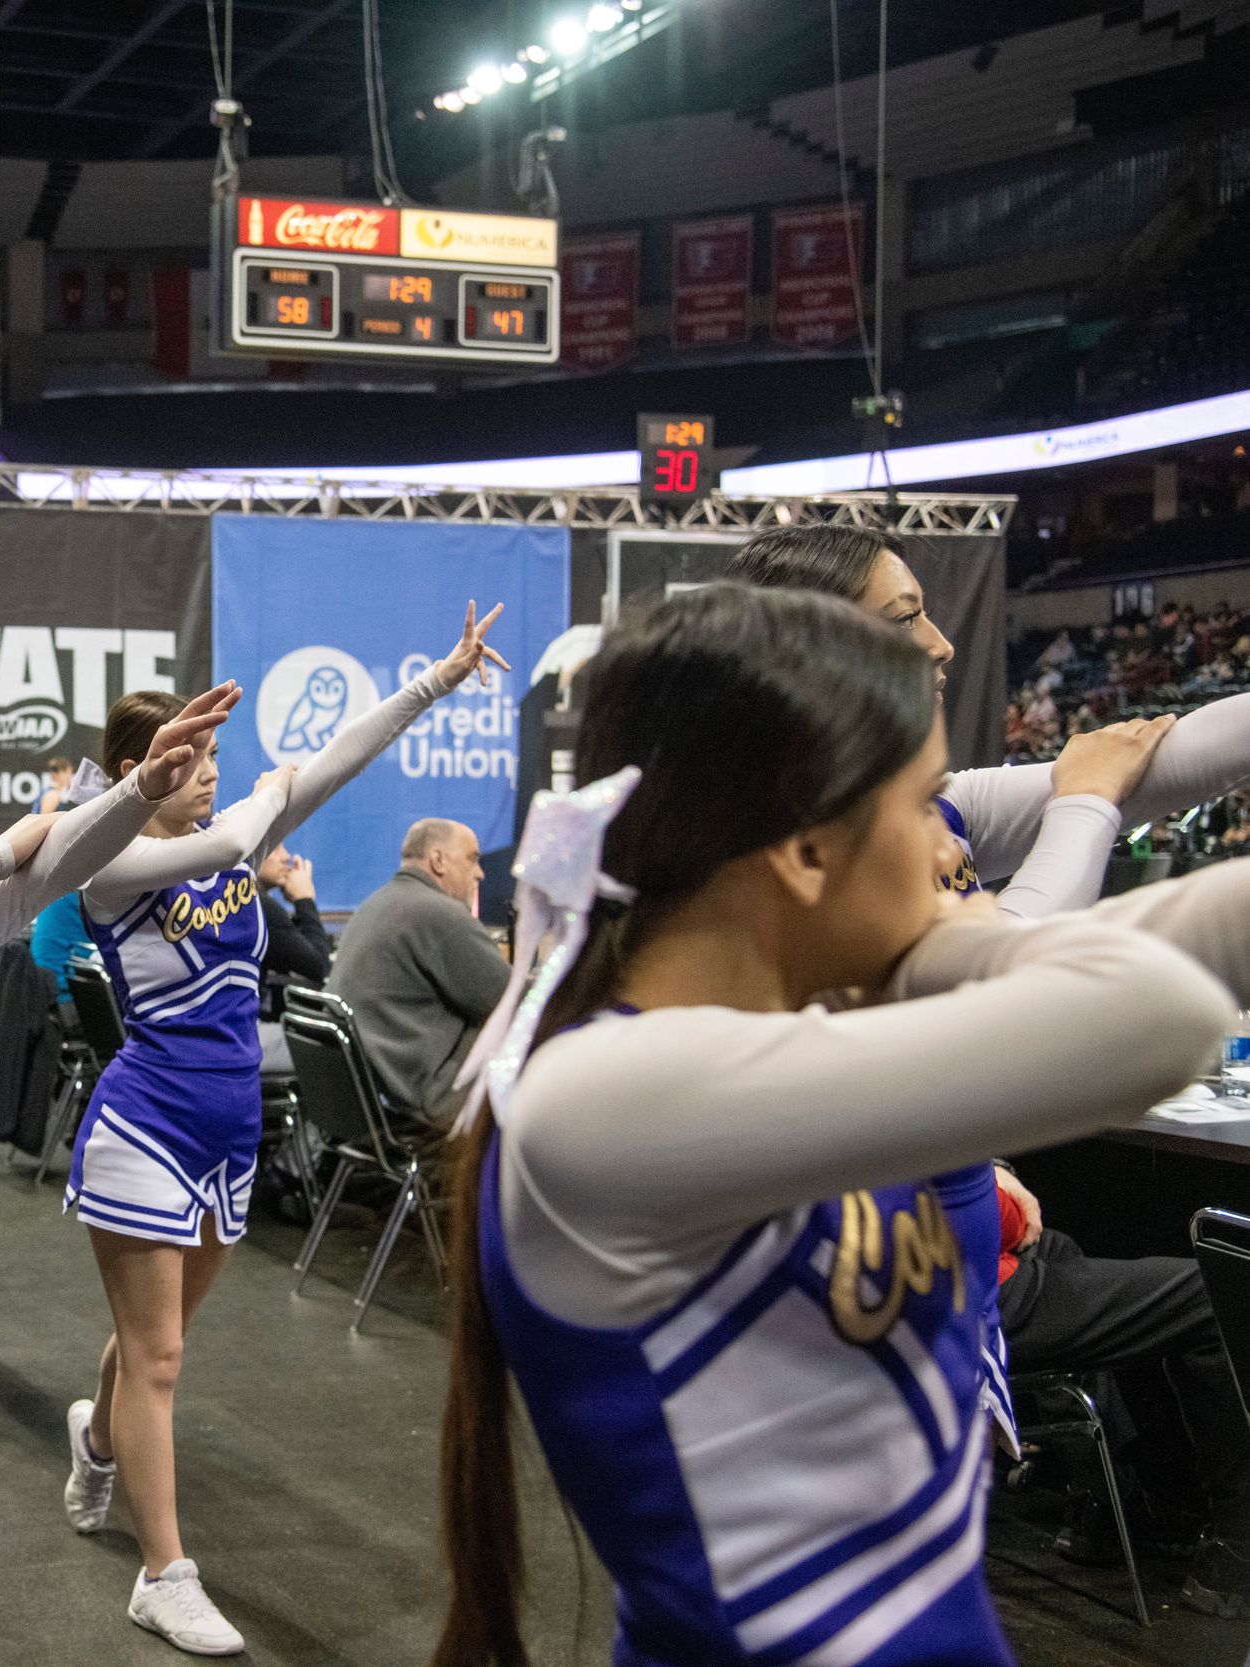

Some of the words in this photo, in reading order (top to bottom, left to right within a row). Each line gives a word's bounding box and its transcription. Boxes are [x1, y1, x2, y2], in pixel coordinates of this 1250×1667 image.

[275, 204, 385, 250] Coca-Cola
[389, 275, 432, 303] 1:29
[277, 296, 310, 325] 58
[493, 310, 524, 336] 47
[415, 316, 432, 340] 4
[654, 449, 698, 492] 30
[400, 735, 513, 778] Union
